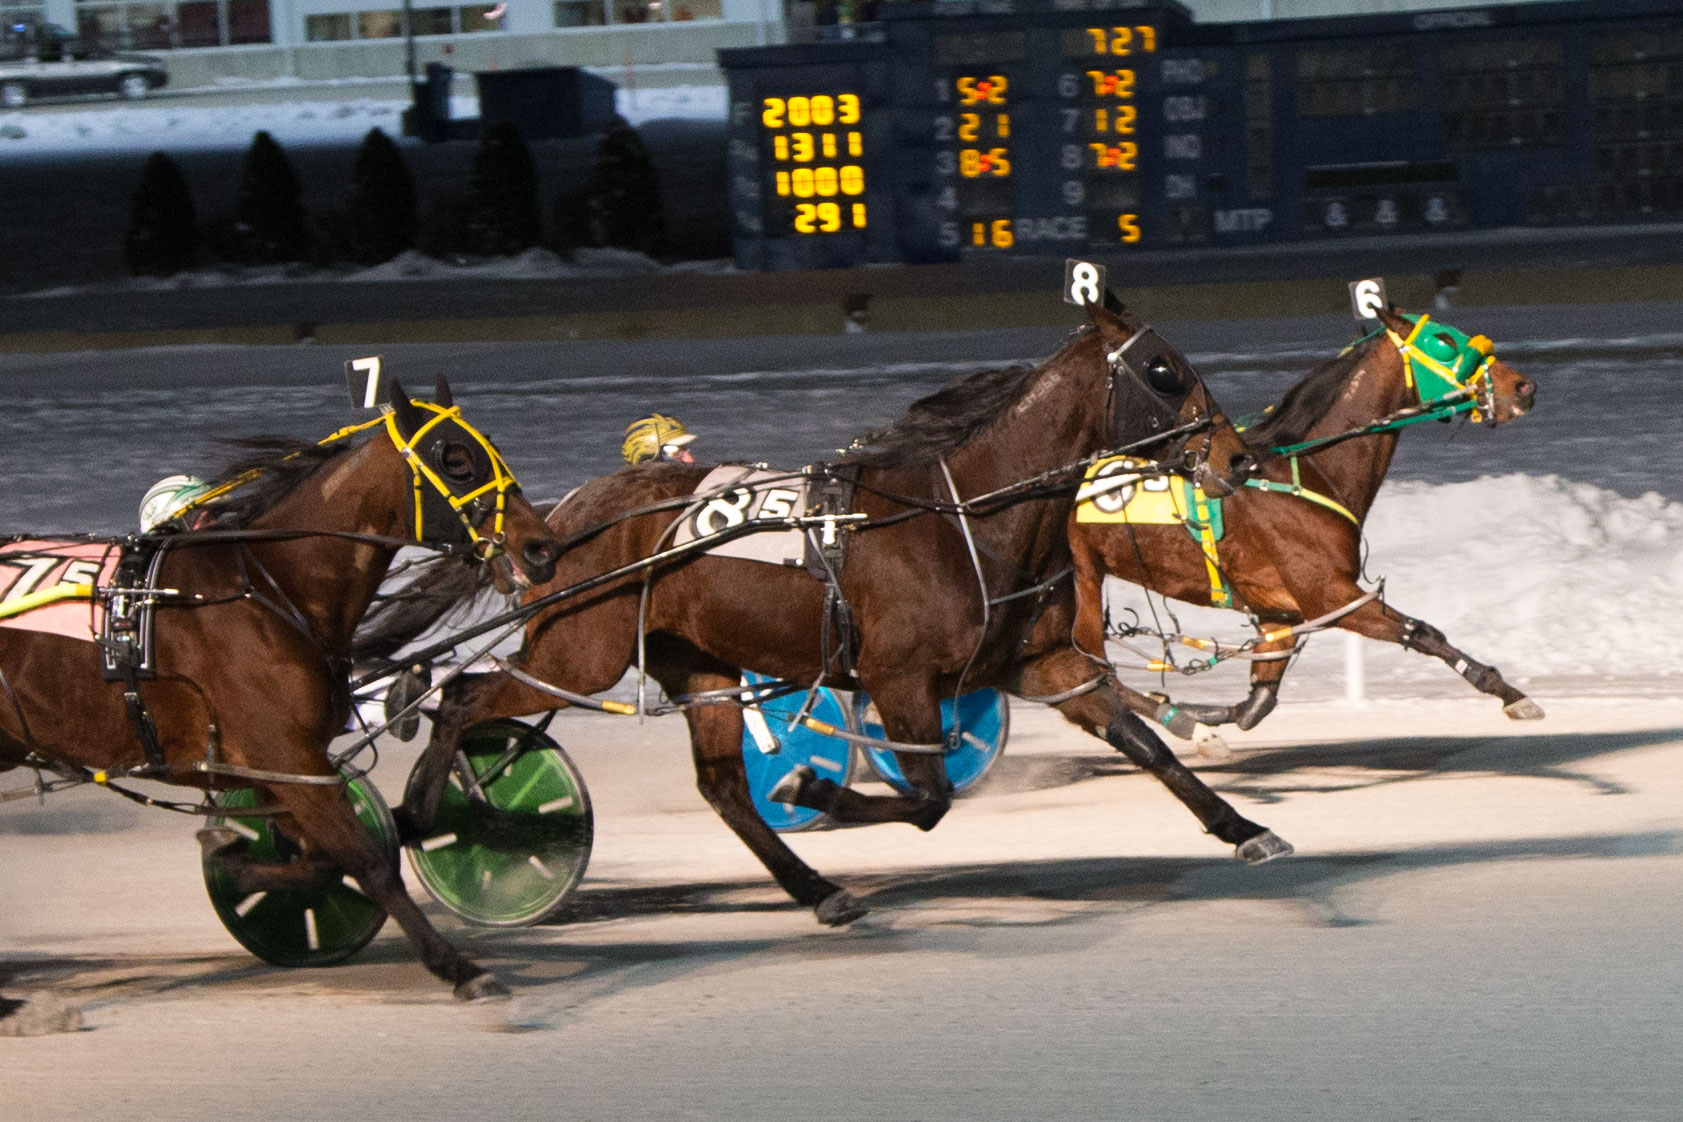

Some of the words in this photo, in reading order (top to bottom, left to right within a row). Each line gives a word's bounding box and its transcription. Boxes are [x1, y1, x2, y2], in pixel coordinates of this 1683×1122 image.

[1016, 216, 1086, 240] RACE
[1117, 213, 1142, 243] 5
[1071, 262, 1099, 306] 8
[1355, 279, 1383, 319] 6
[352, 356, 380, 408] 7
